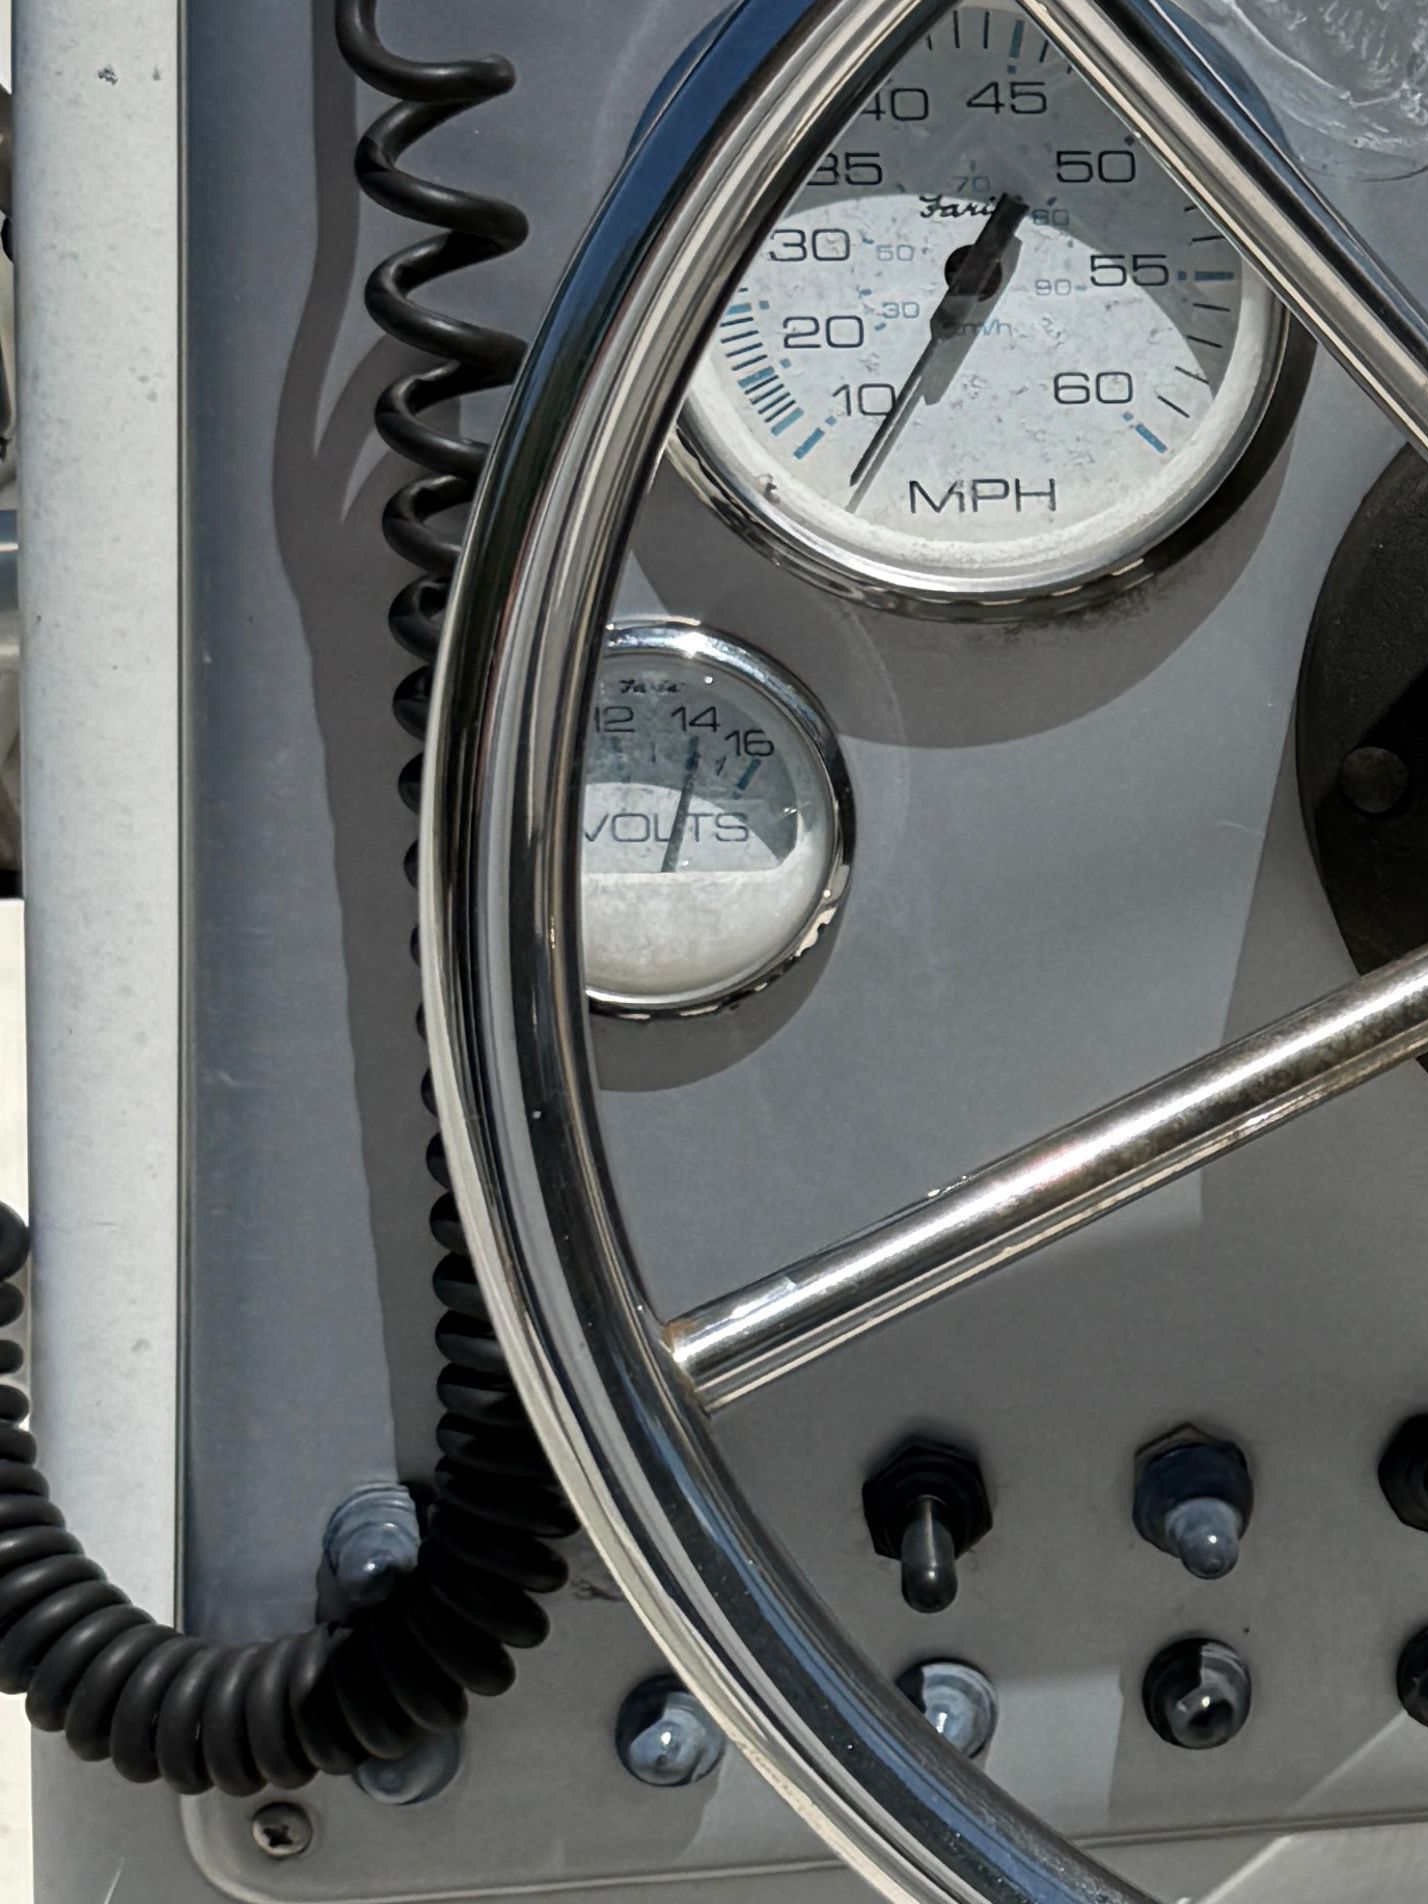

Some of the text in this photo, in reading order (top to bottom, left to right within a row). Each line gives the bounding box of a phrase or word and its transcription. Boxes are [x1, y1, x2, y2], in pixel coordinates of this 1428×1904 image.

[965, 81, 1047, 116] 45
[952, 175, 991, 194] 70
[1055, 150, 1136, 185] 50
[918, 192, 996, 218] Fari
[769, 227, 851, 262] 30
[1034, 278, 1073, 297] 90
[1089, 254, 1170, 288] 55
[882, 301, 921, 319] 30
[781, 316, 865, 350] 20
[831, 381, 898, 417] 10
[1052, 371, 1134, 405] 60
[907, 477, 1058, 515] MPH
[671, 705, 721, 733] 14
[724, 728, 775, 758] 16
[583, 812, 750, 843] VOLTS
